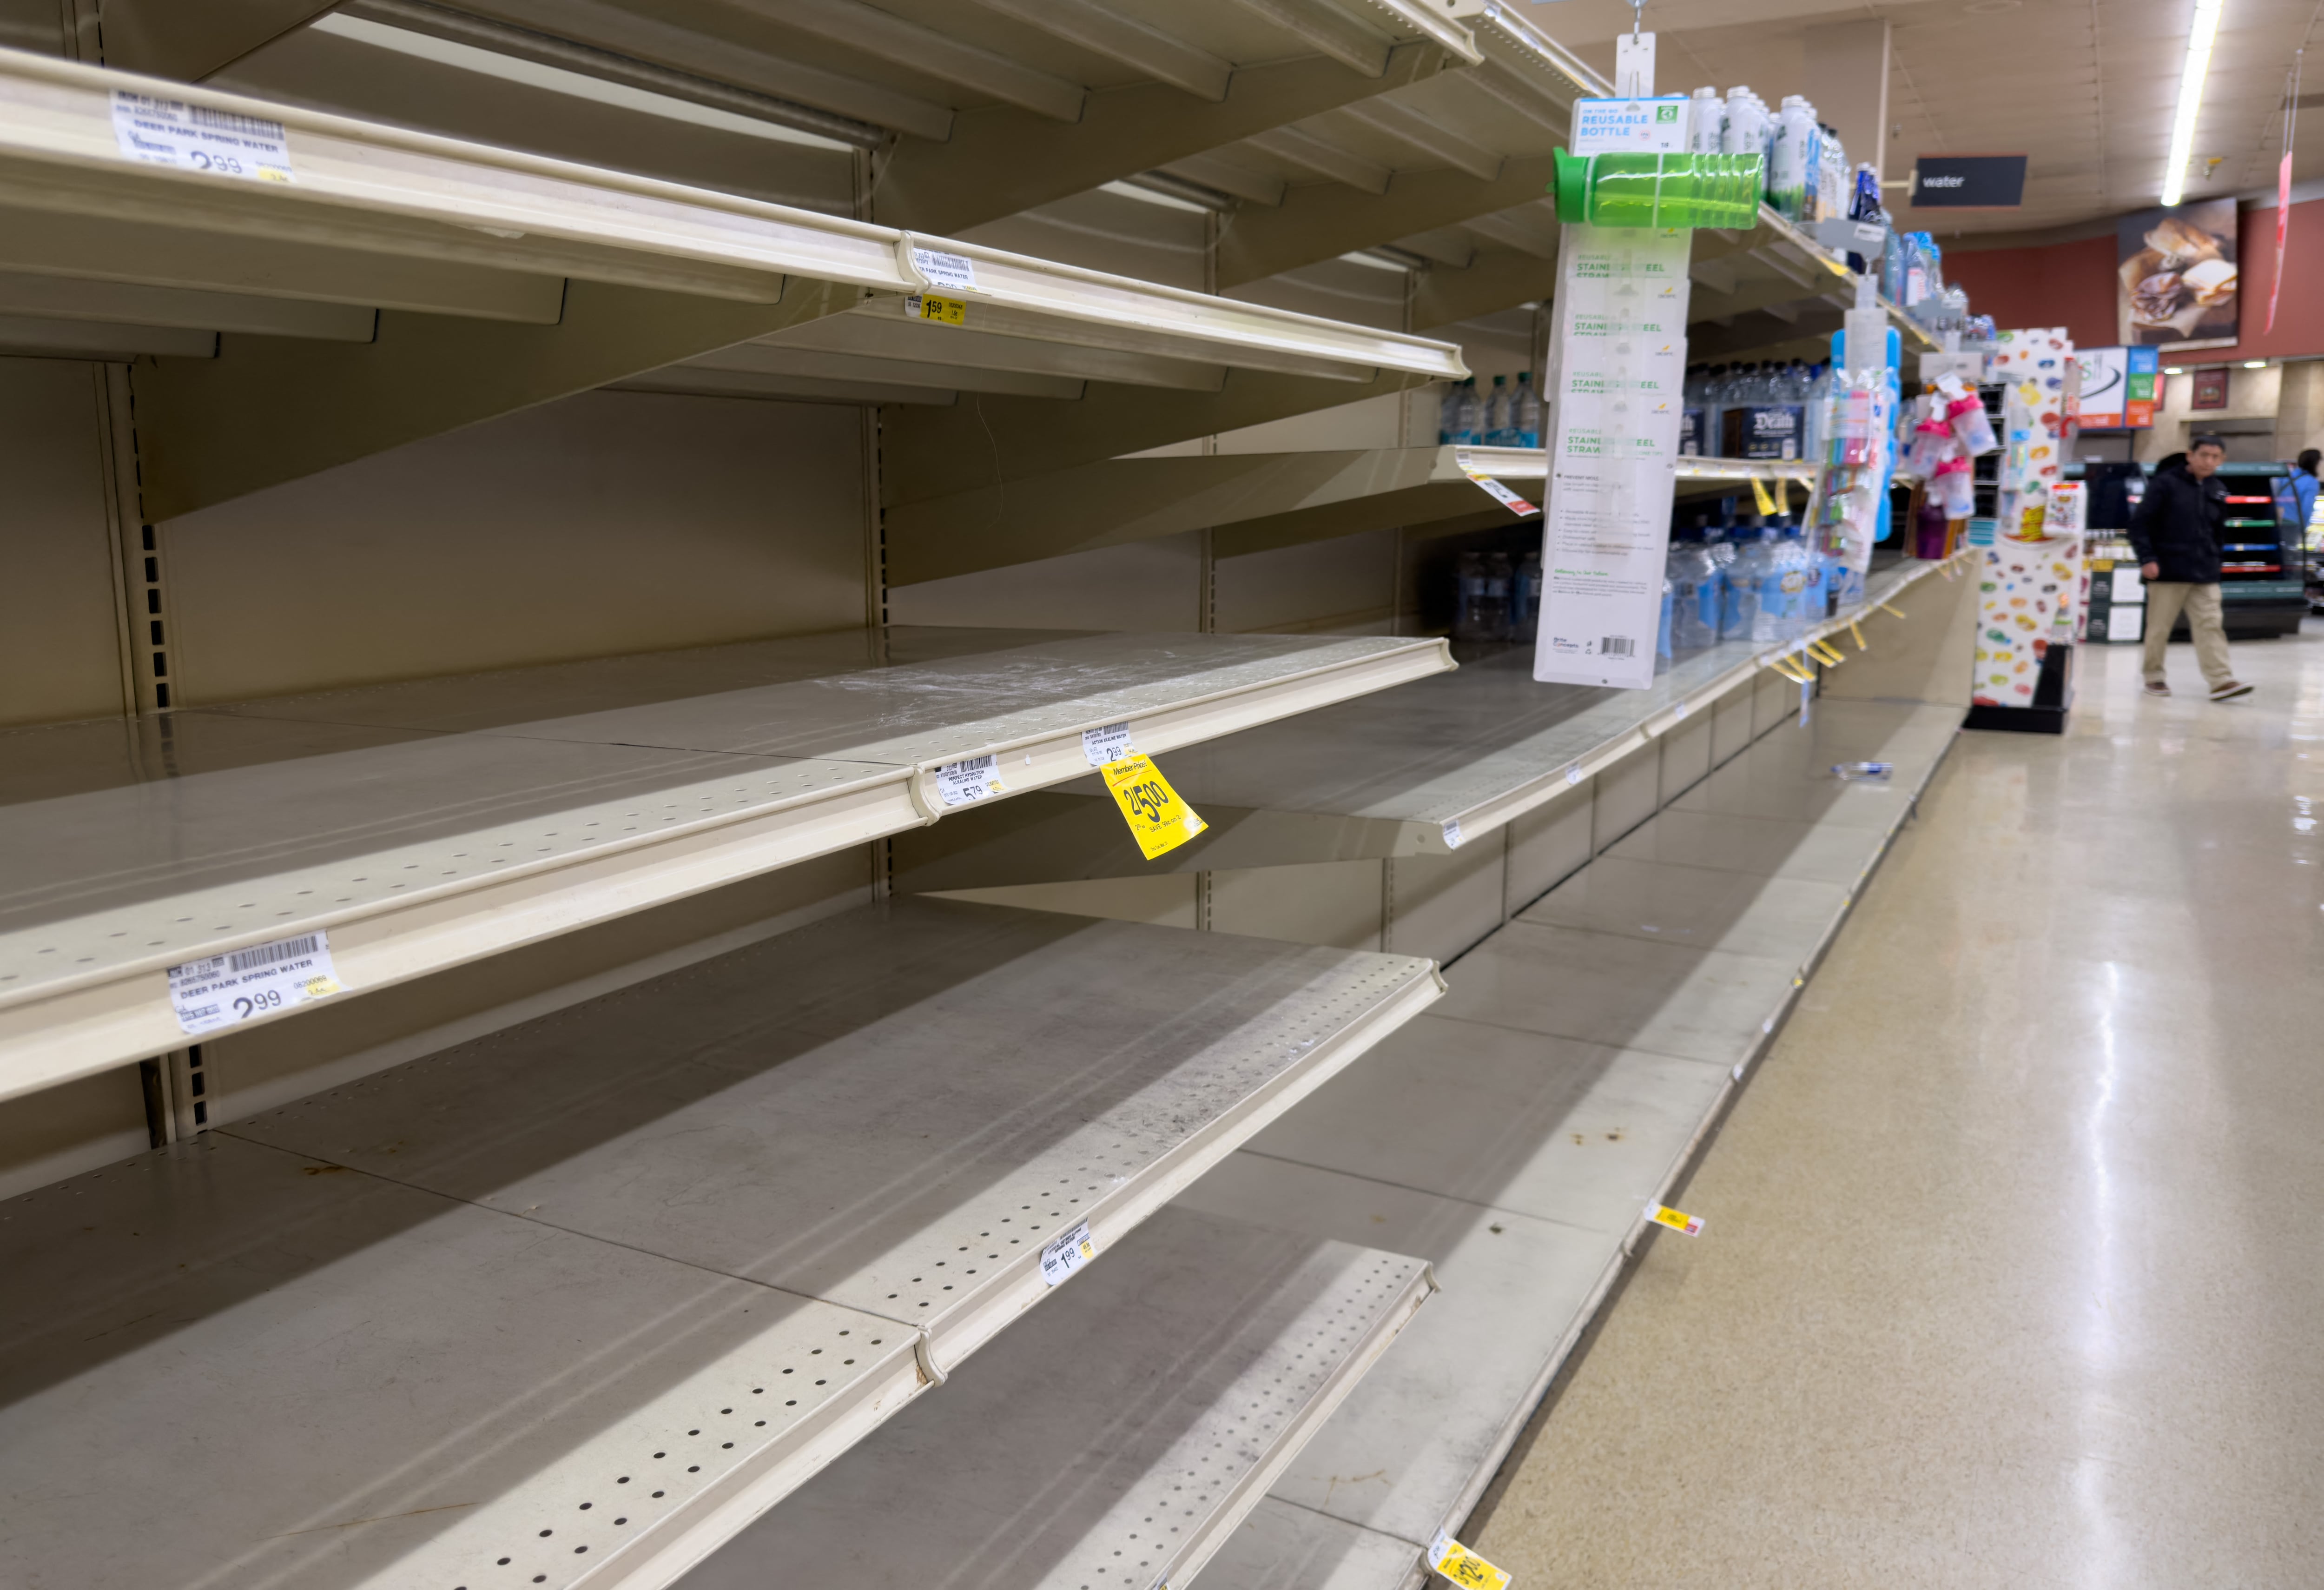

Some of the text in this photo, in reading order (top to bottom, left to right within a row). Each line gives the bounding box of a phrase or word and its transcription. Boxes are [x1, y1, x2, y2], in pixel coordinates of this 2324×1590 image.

[1582, 115, 1648, 125] REUSABLE
[134, 119, 279, 153] DEER PARK SPRING WATER
[1580, 127, 1630, 136] BOTTLE
[1923, 175, 1964, 187] water
[926, 299, 942, 318] 159
[1106, 746, 1122, 762] 299
[1114, 760, 1147, 776] Member Price!
[1149, 824, 1162, 832] SAVE
[181, 959, 313, 999] DEER PARK SPRING WATER
[233, 989, 282, 1019] 299
[1061, 1247, 1075, 1269] 199
